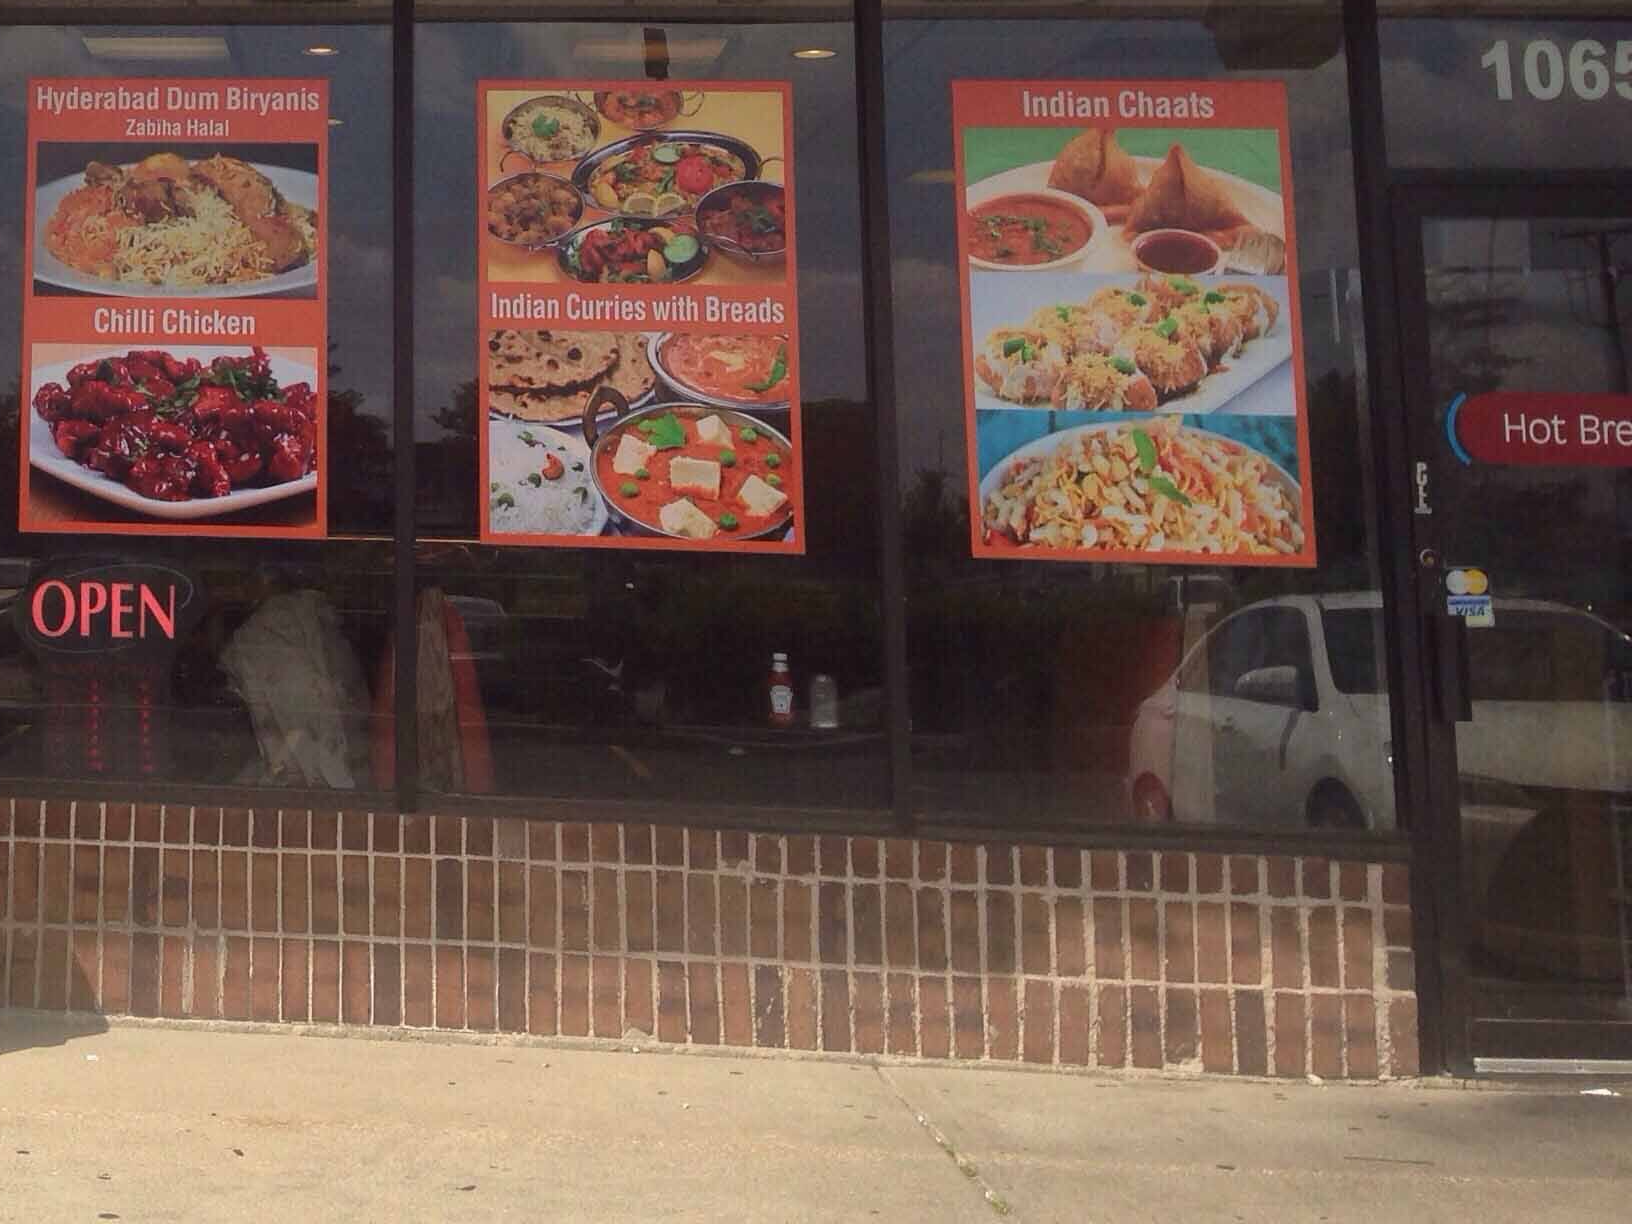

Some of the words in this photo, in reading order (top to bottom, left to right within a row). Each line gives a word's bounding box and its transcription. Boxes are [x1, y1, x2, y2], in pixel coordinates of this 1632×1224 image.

[36, 86, 159, 116] Hyderabad
[167, 87, 219, 111] Dum
[226, 87, 320, 116] Biryanis
[1023, 90, 1110, 118] Indian
[1118, 90, 1215, 118] Chaats
[126, 118, 182, 137] Zabiha
[186, 119, 230, 137] Halal
[94, 307, 155, 334] Chilli
[162, 307, 256, 336] Chicken
[491, 292, 559, 320] Indian
[566, 292, 646, 321] Curries
[652, 295, 699, 322] with
[705, 295, 785, 323] Breads
[1504, 412, 1567, 445] Hot
[32, 580, 175, 639] OPEN
[1456, 606, 1486, 616] VISA
